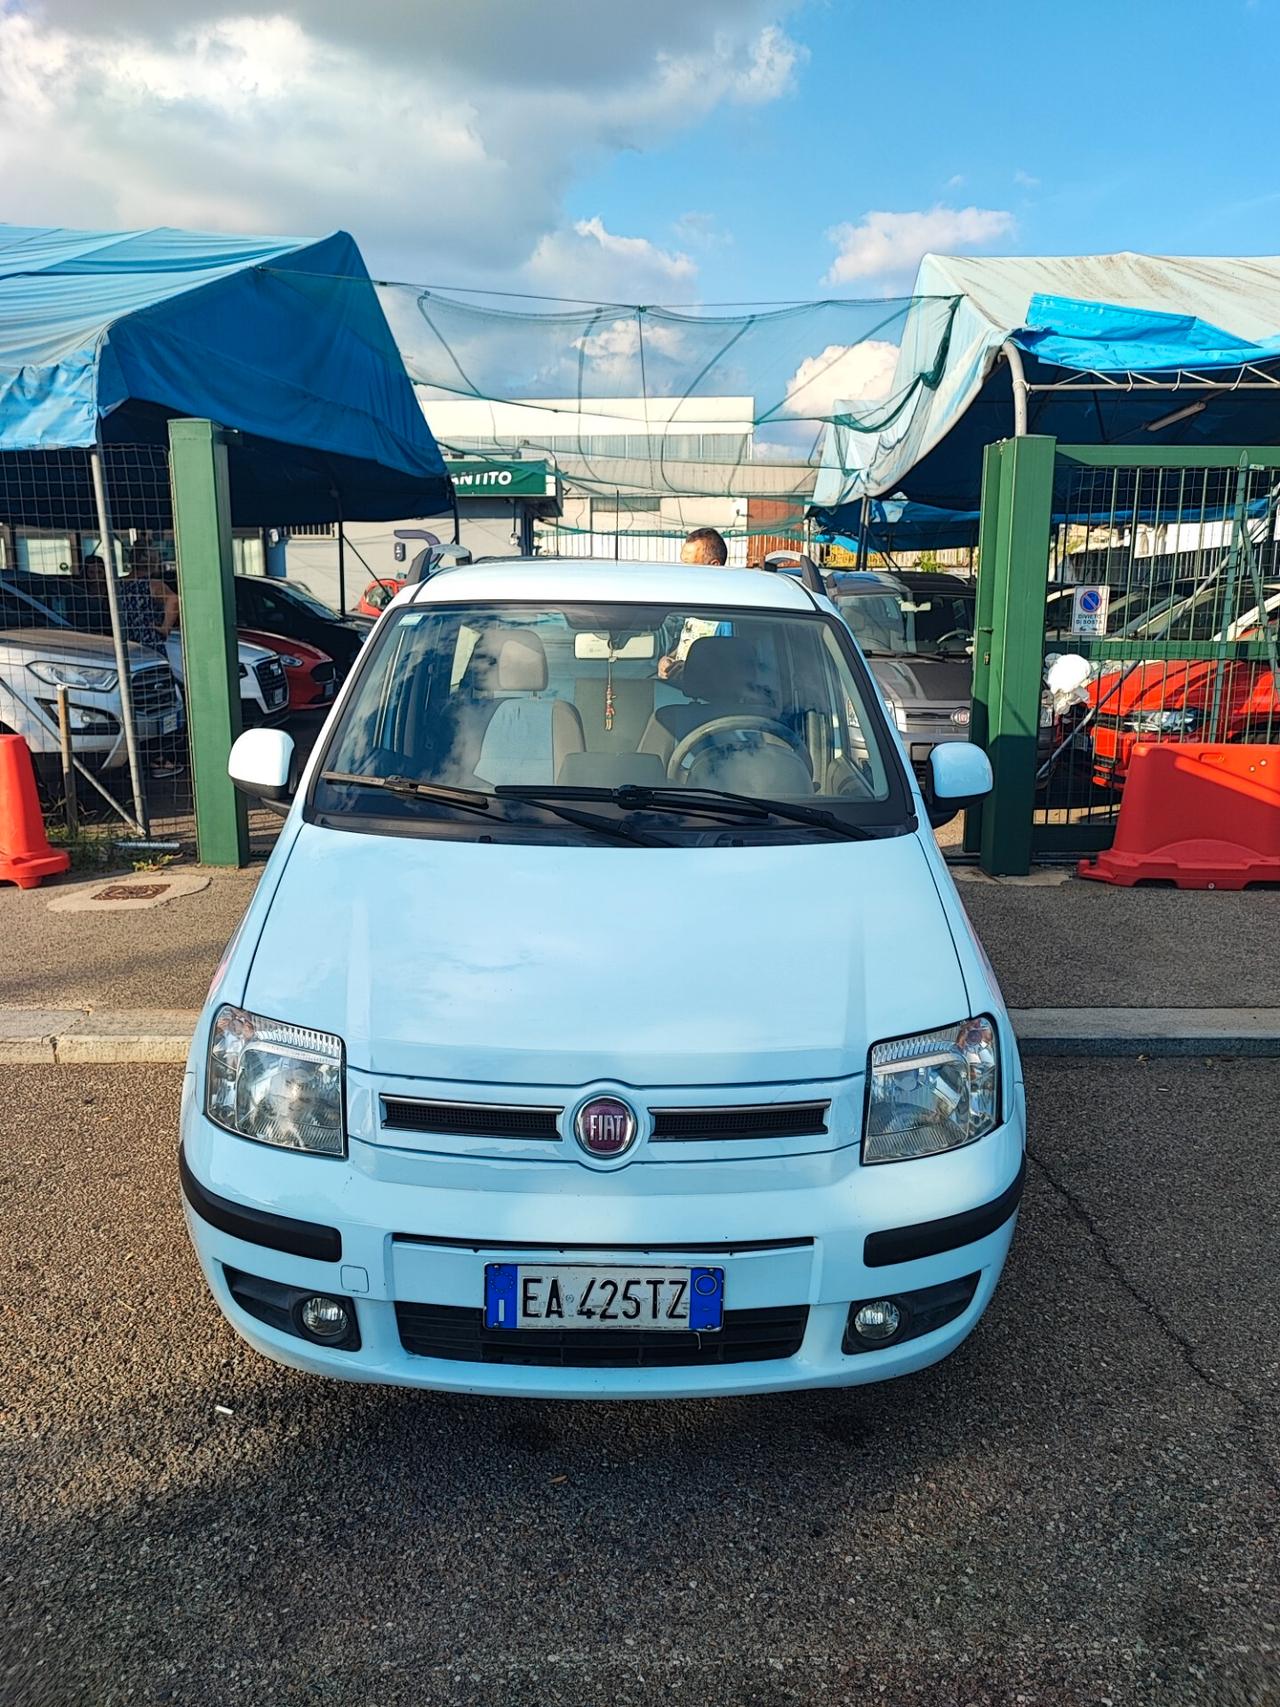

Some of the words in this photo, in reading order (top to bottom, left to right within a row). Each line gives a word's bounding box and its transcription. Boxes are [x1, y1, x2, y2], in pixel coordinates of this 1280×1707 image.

[590, 1115, 624, 1141] FIAT
[521, 1277, 564, 1319] EA
[577, 1277, 689, 1320] 425TZ
